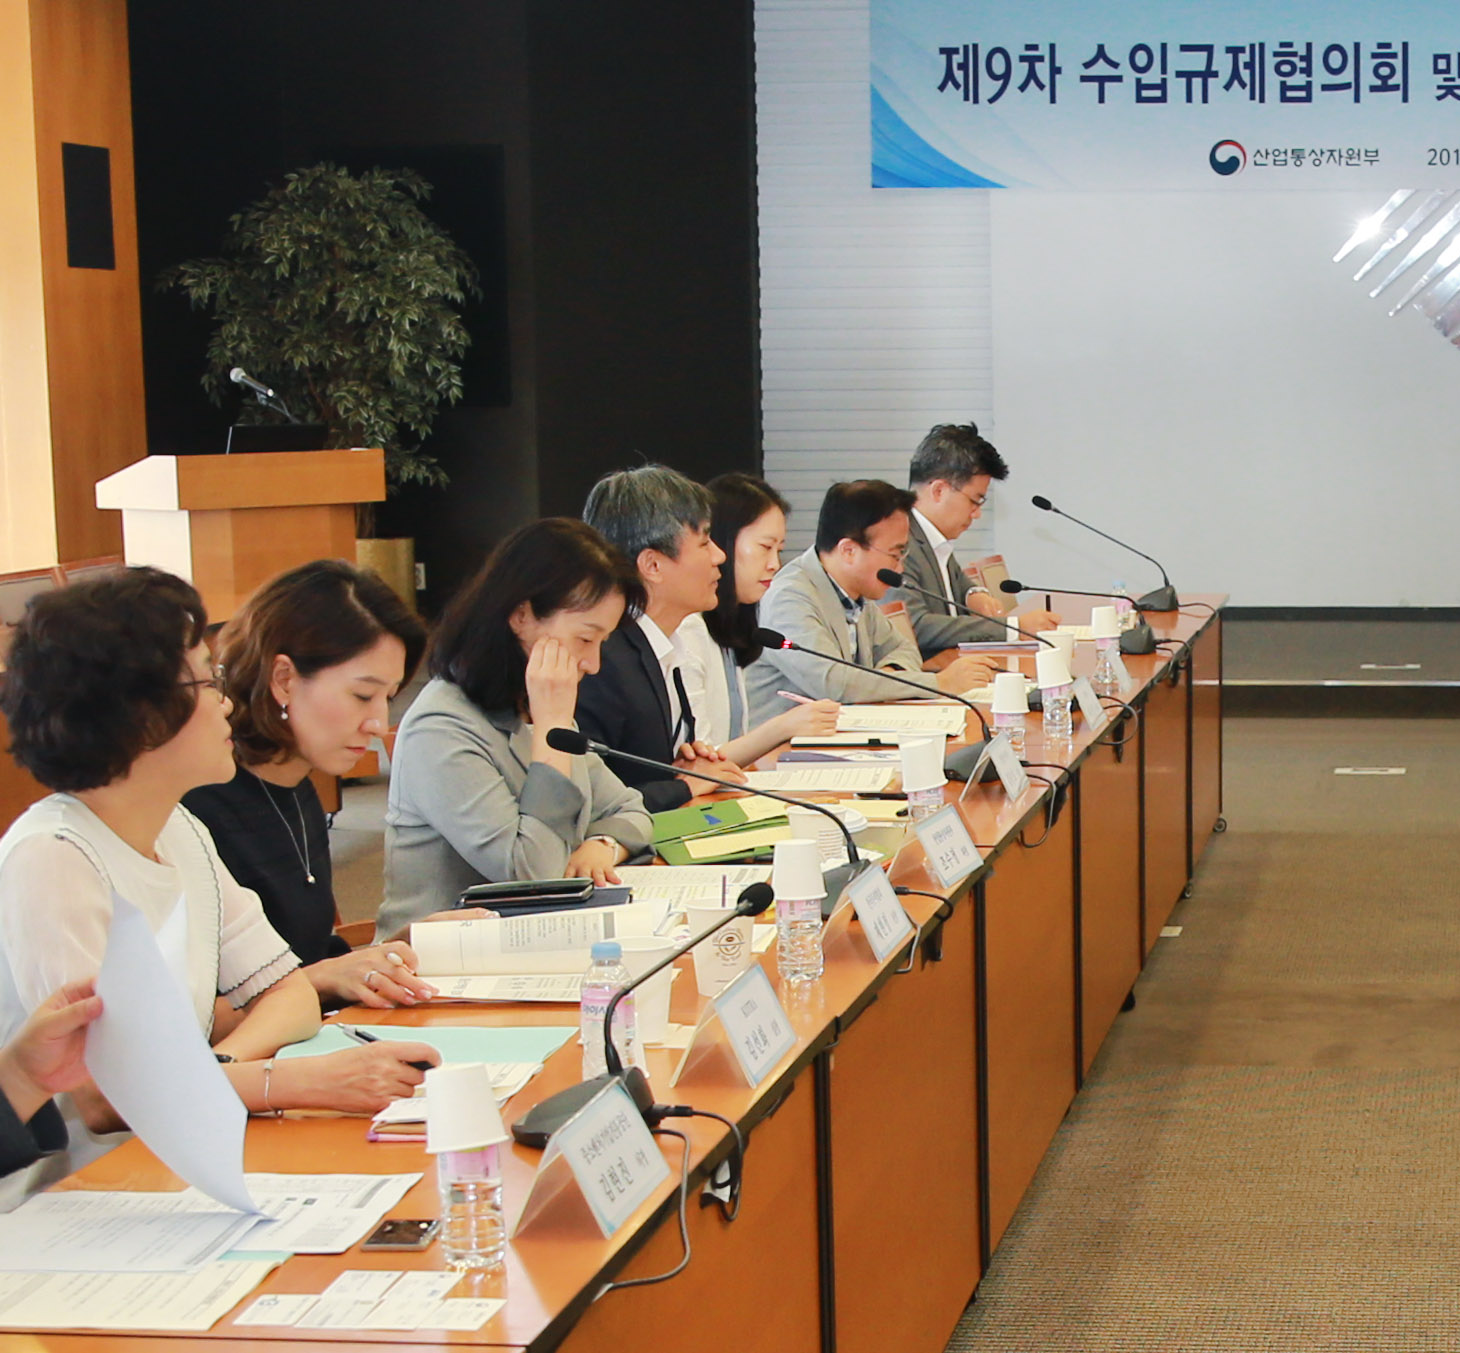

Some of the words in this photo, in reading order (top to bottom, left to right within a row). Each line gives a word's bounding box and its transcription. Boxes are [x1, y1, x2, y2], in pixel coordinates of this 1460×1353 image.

[936, 42, 1063, 105] 제9차
[1079, 40, 1410, 105] 수입규제협의회
[1253, 147, 1380, 168] 산업통상자원부
